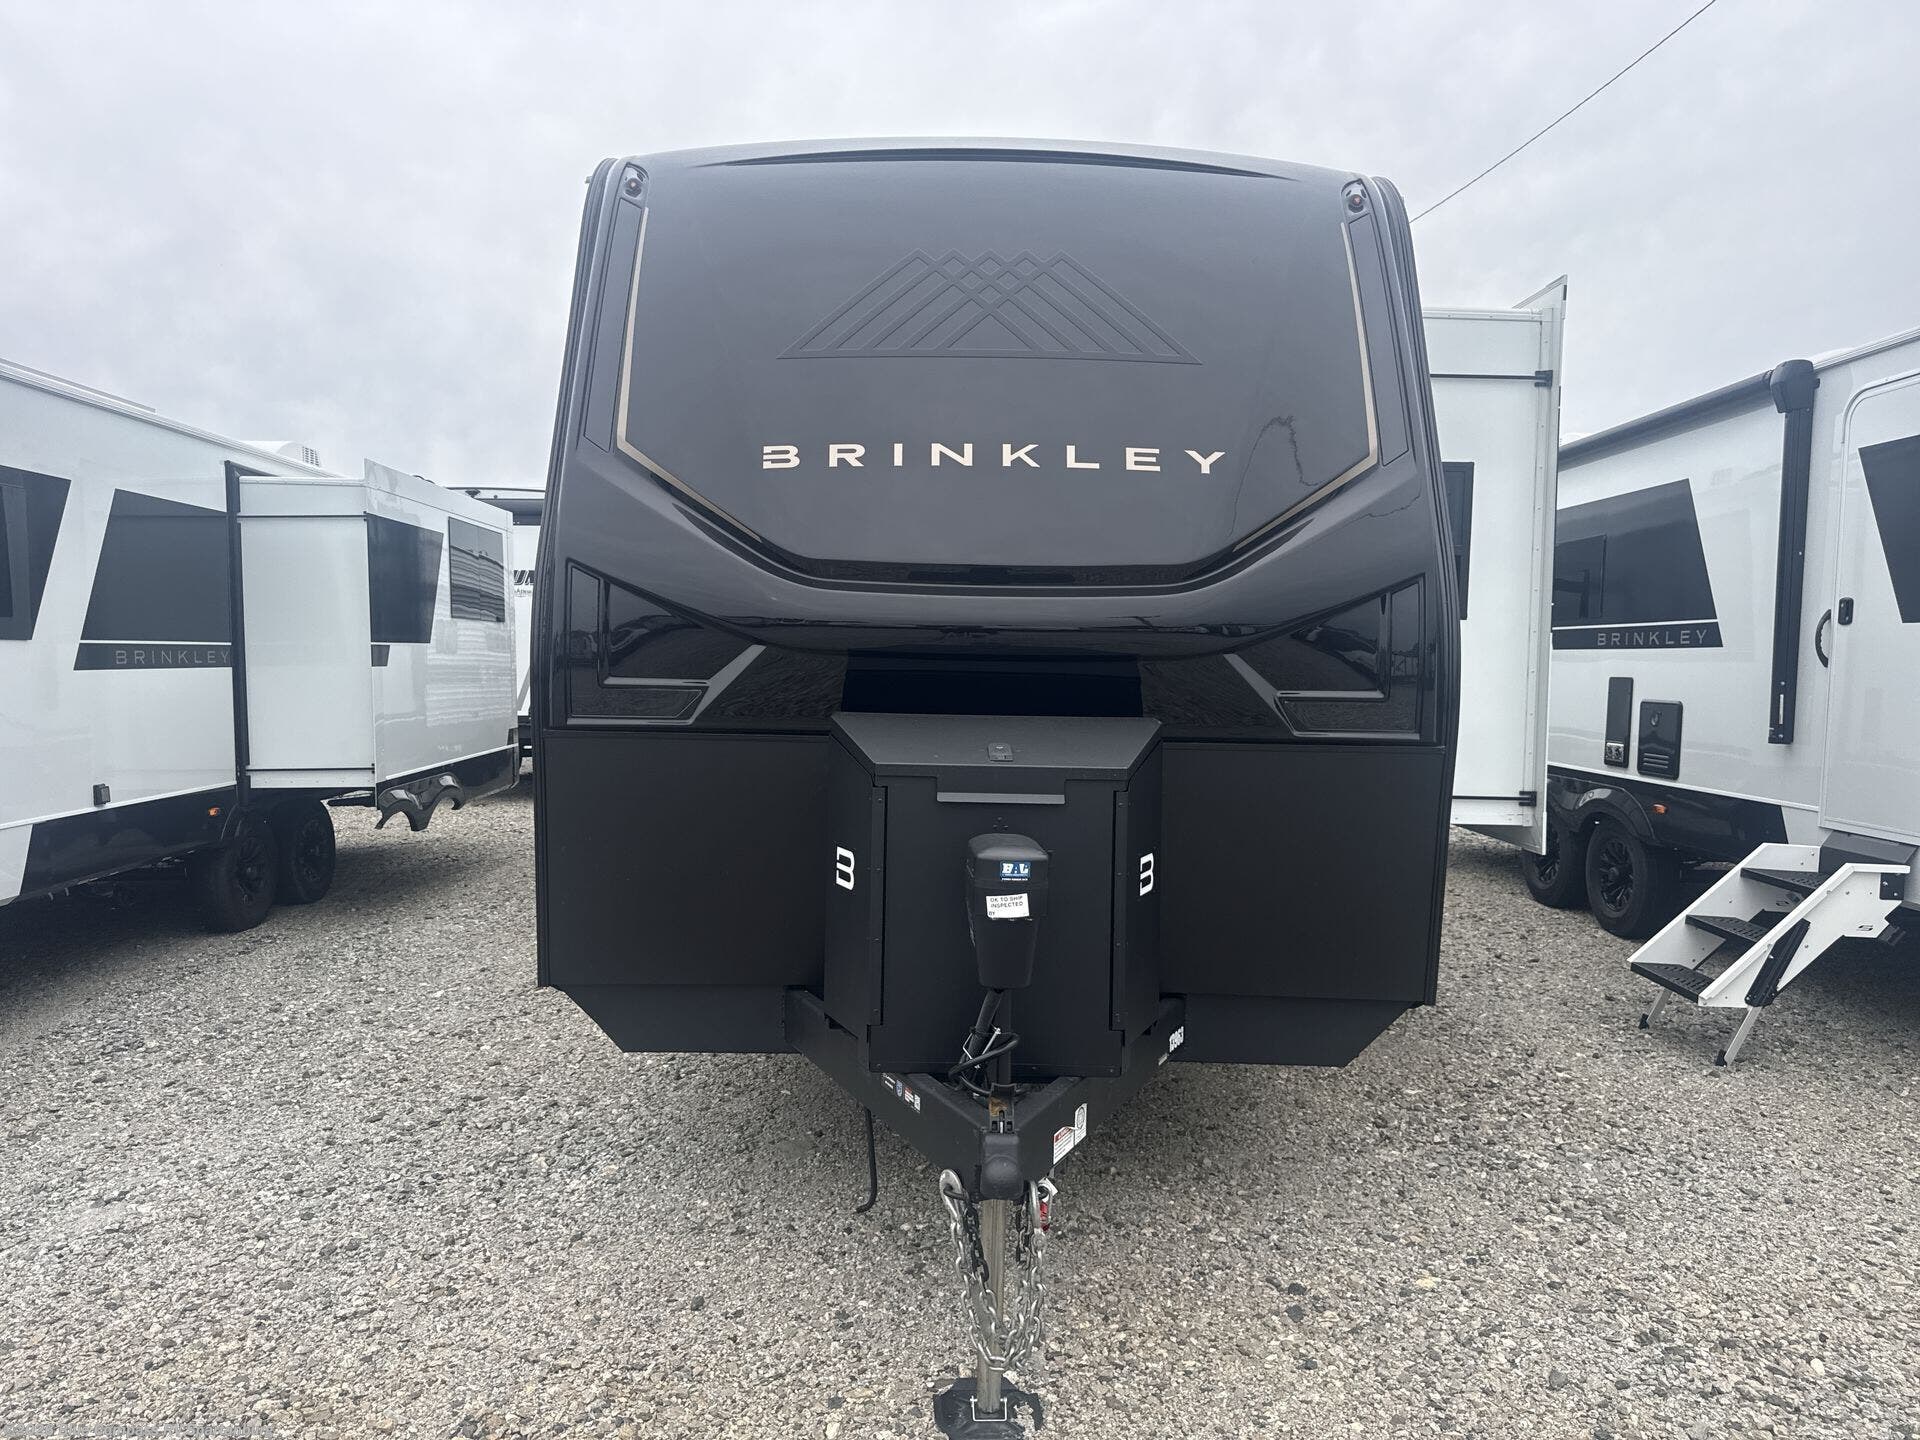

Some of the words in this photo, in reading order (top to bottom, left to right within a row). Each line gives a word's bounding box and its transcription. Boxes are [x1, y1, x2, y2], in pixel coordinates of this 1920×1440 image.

[762, 443, 1226, 474] BRINKLEY
[1597, 629, 1708, 646] BRINKLEY
[115, 650, 230, 665] BRINKLEY
